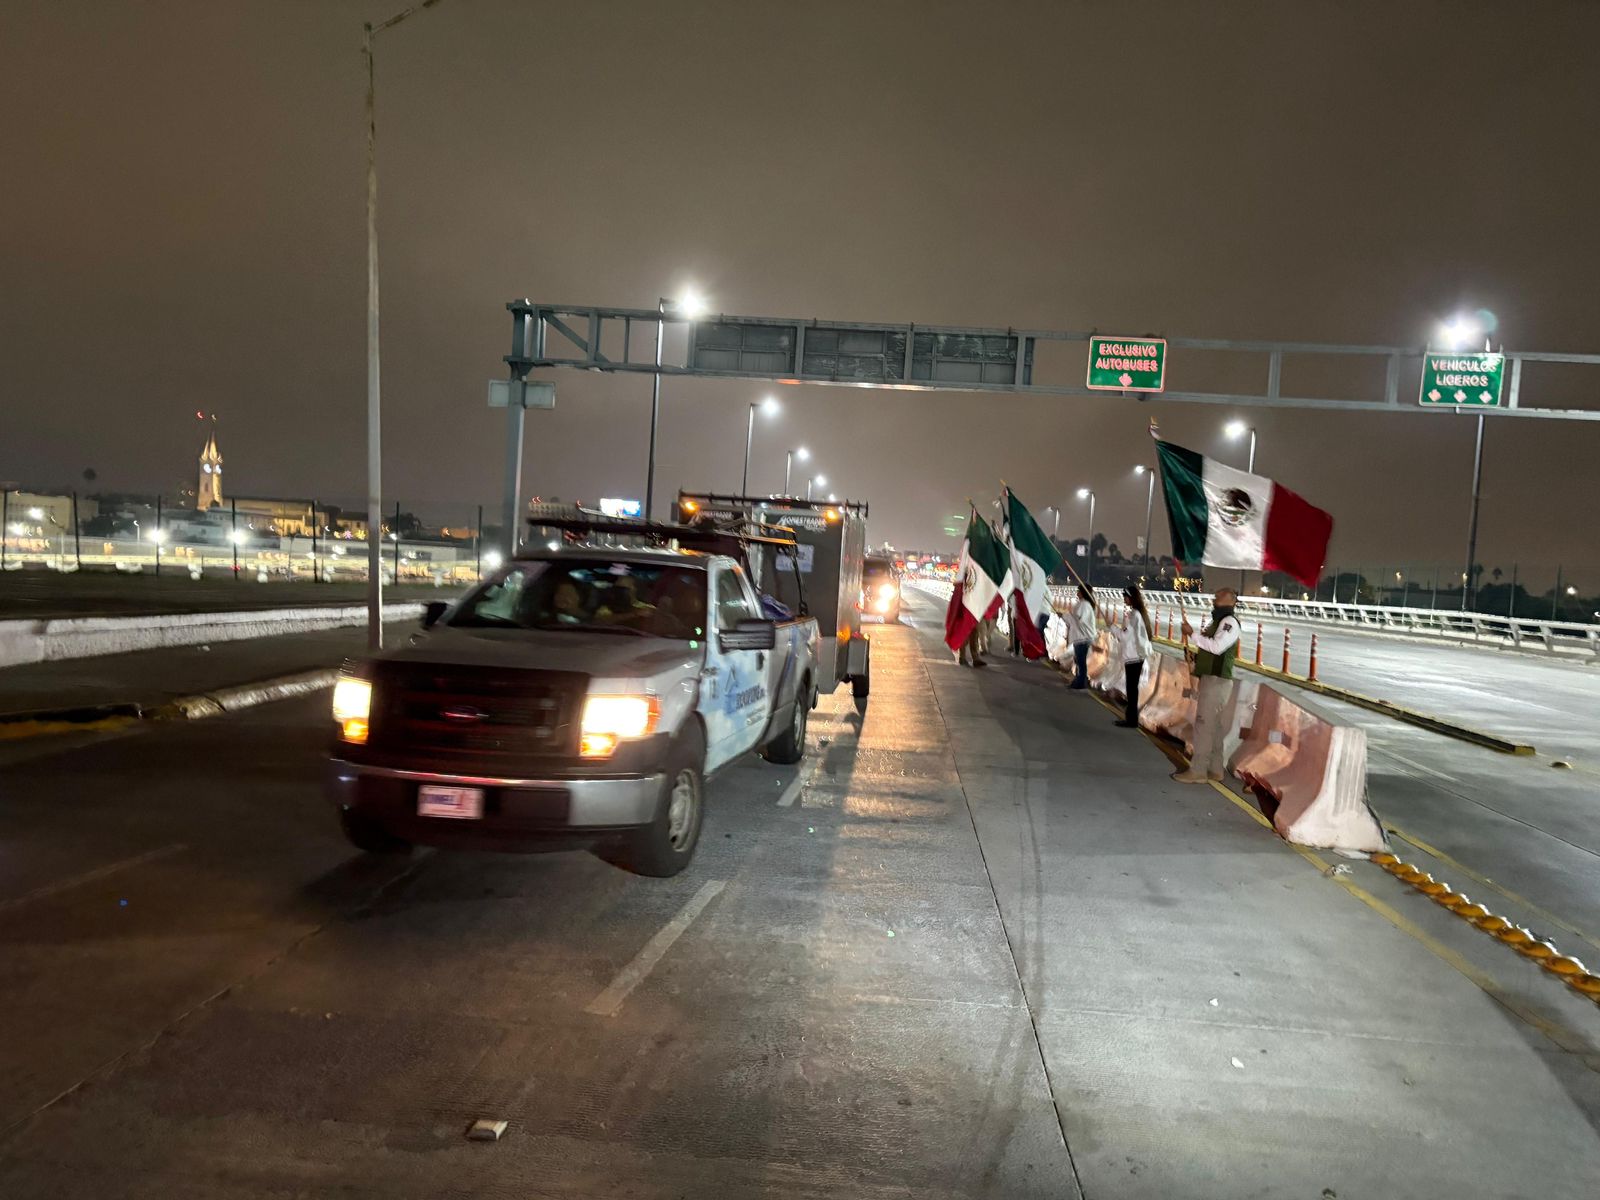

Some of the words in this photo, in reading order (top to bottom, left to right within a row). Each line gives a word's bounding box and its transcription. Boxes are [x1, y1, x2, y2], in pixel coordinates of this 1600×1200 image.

[1099, 343, 1157, 357] EXCLUSIVO
[1095, 357, 1158, 372] AUTOBUSES
[1436, 373, 1488, 386] LIGEROS
